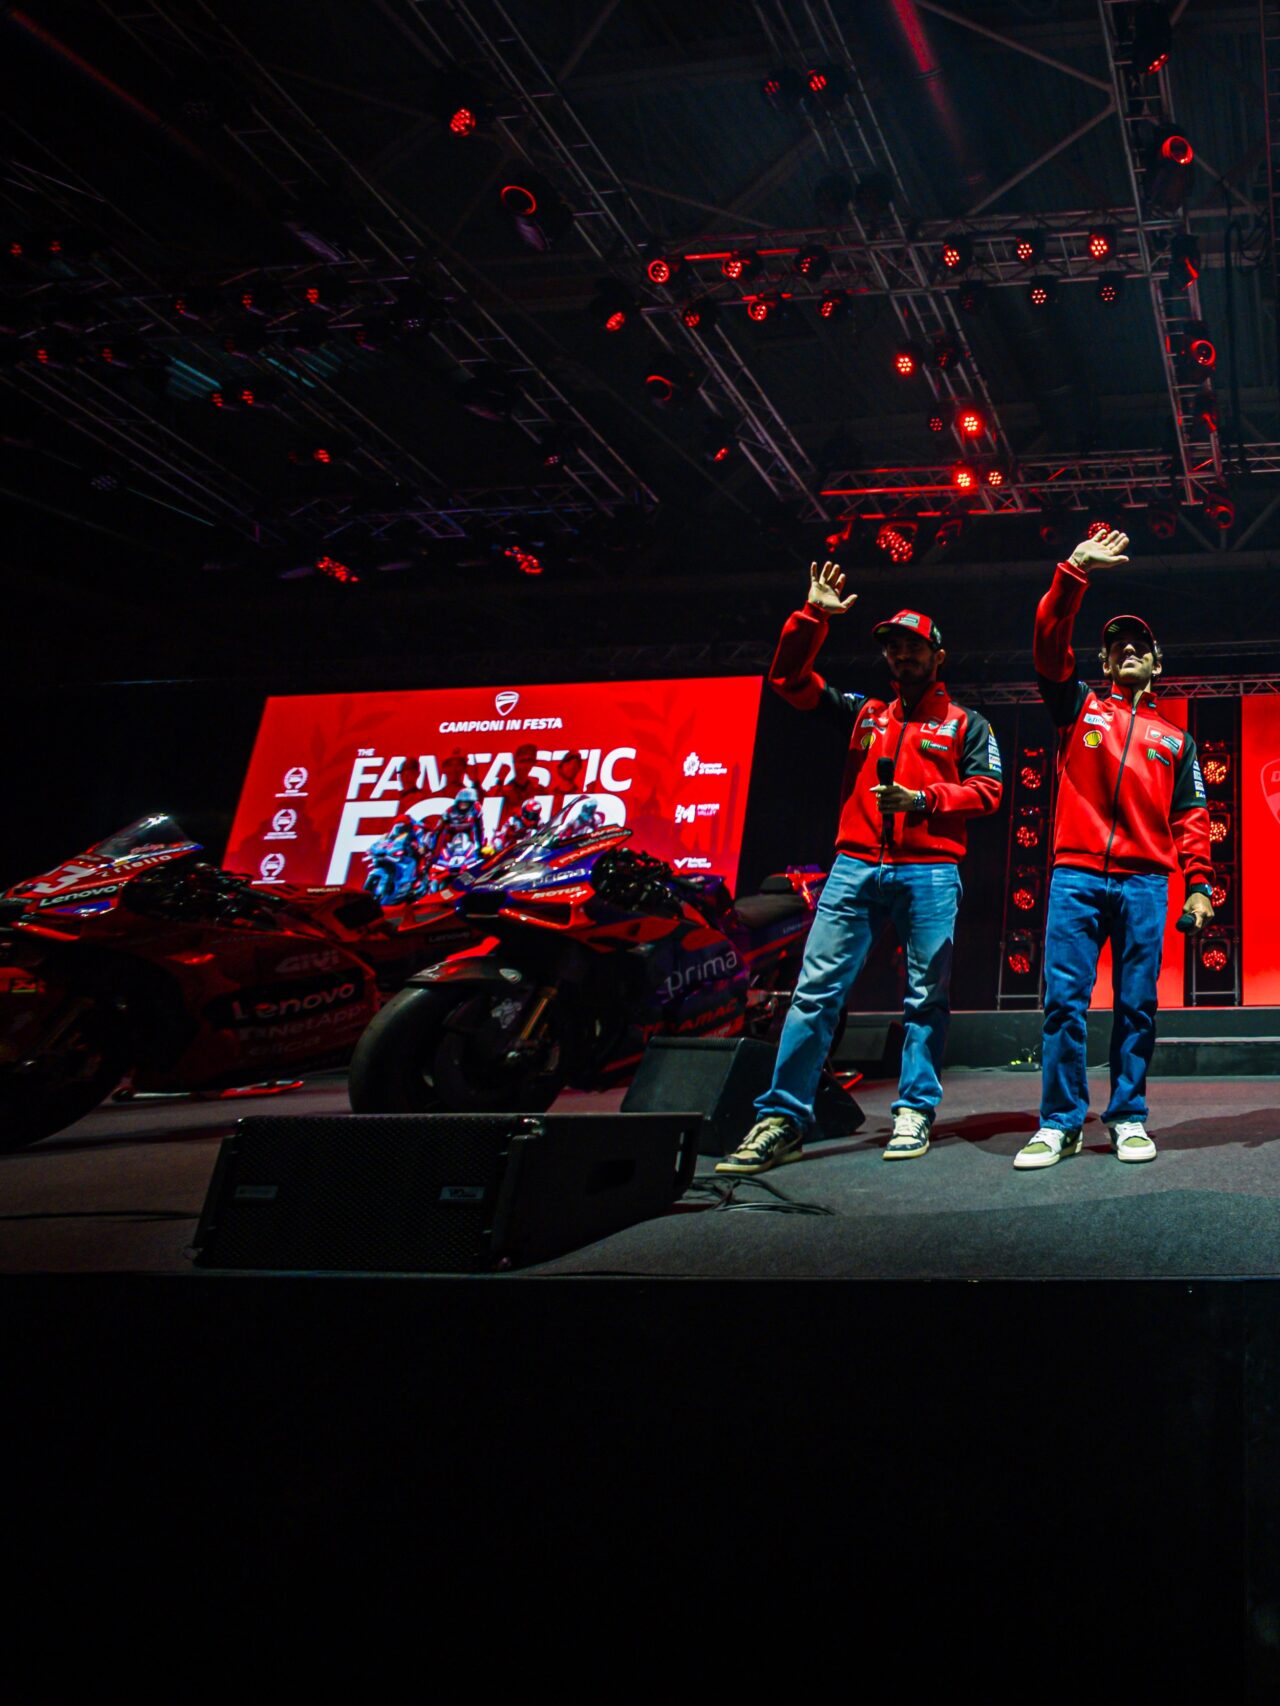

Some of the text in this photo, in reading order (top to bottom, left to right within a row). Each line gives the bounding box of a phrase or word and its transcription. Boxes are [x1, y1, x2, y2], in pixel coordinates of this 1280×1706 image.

[439, 717, 563, 733] CAMPIONI IN FESTA
[358, 748, 376, 757] THE
[39, 884, 119, 908] Lenovo
[275, 949, 339, 973] GIVI
[664, 950, 738, 999] prima
[230, 981, 355, 1021] Lenovo
